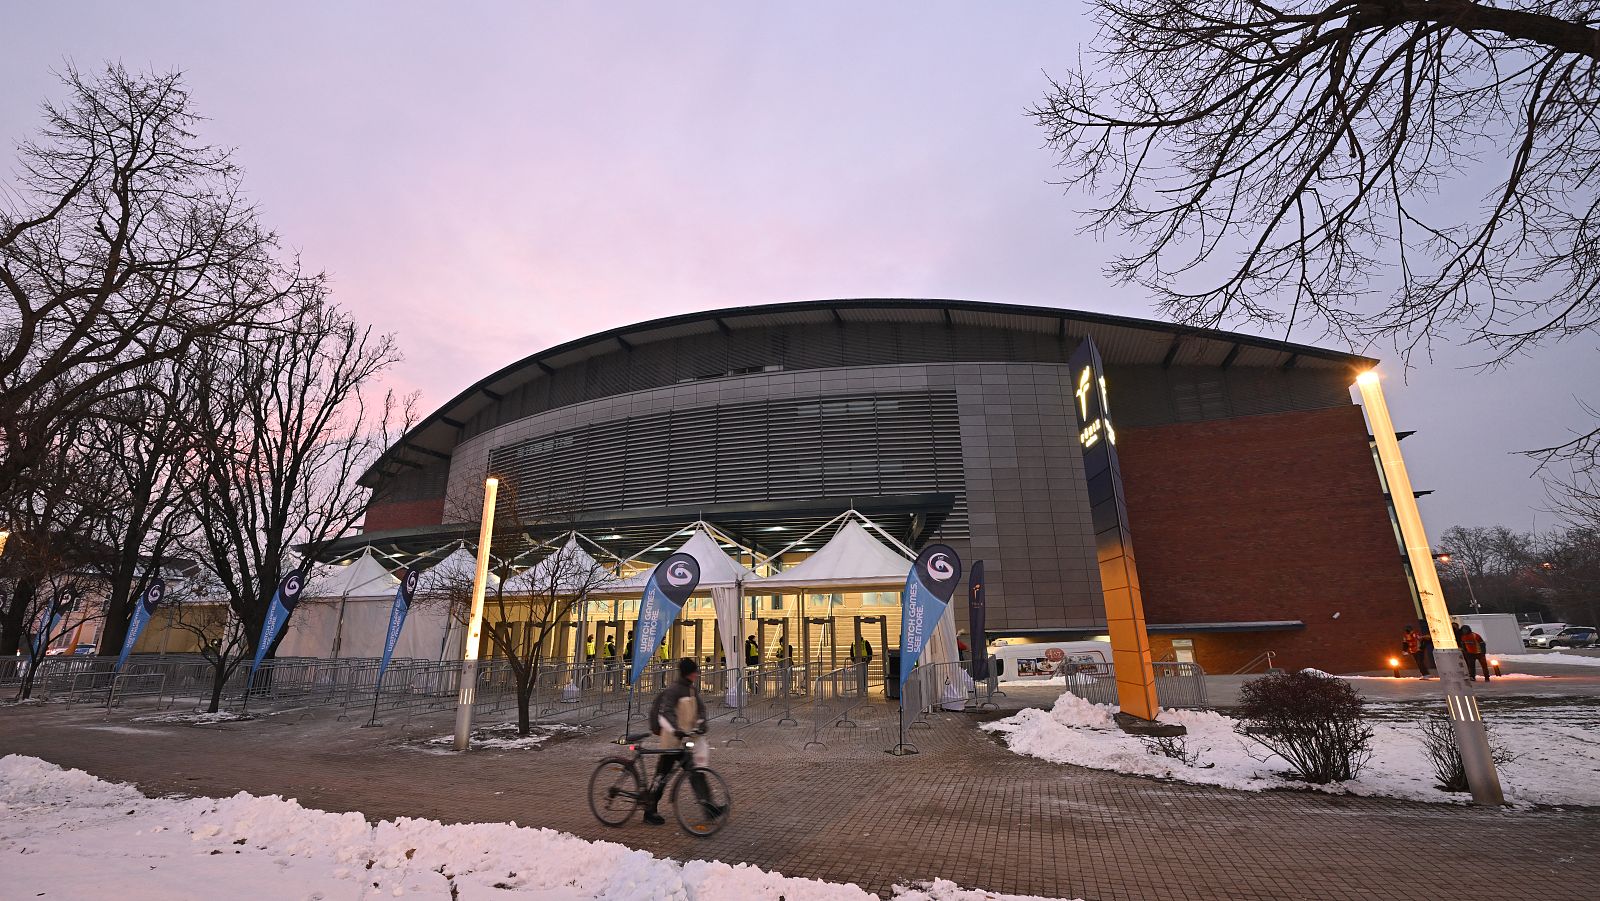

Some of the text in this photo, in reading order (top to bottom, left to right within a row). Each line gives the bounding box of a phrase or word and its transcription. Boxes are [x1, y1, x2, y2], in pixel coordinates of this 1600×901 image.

[640, 588, 656, 652] WATCH GAMES.
[907, 582, 918, 653] WATCH GAMES.
[914, 605, 924, 653] SEE MORE.
